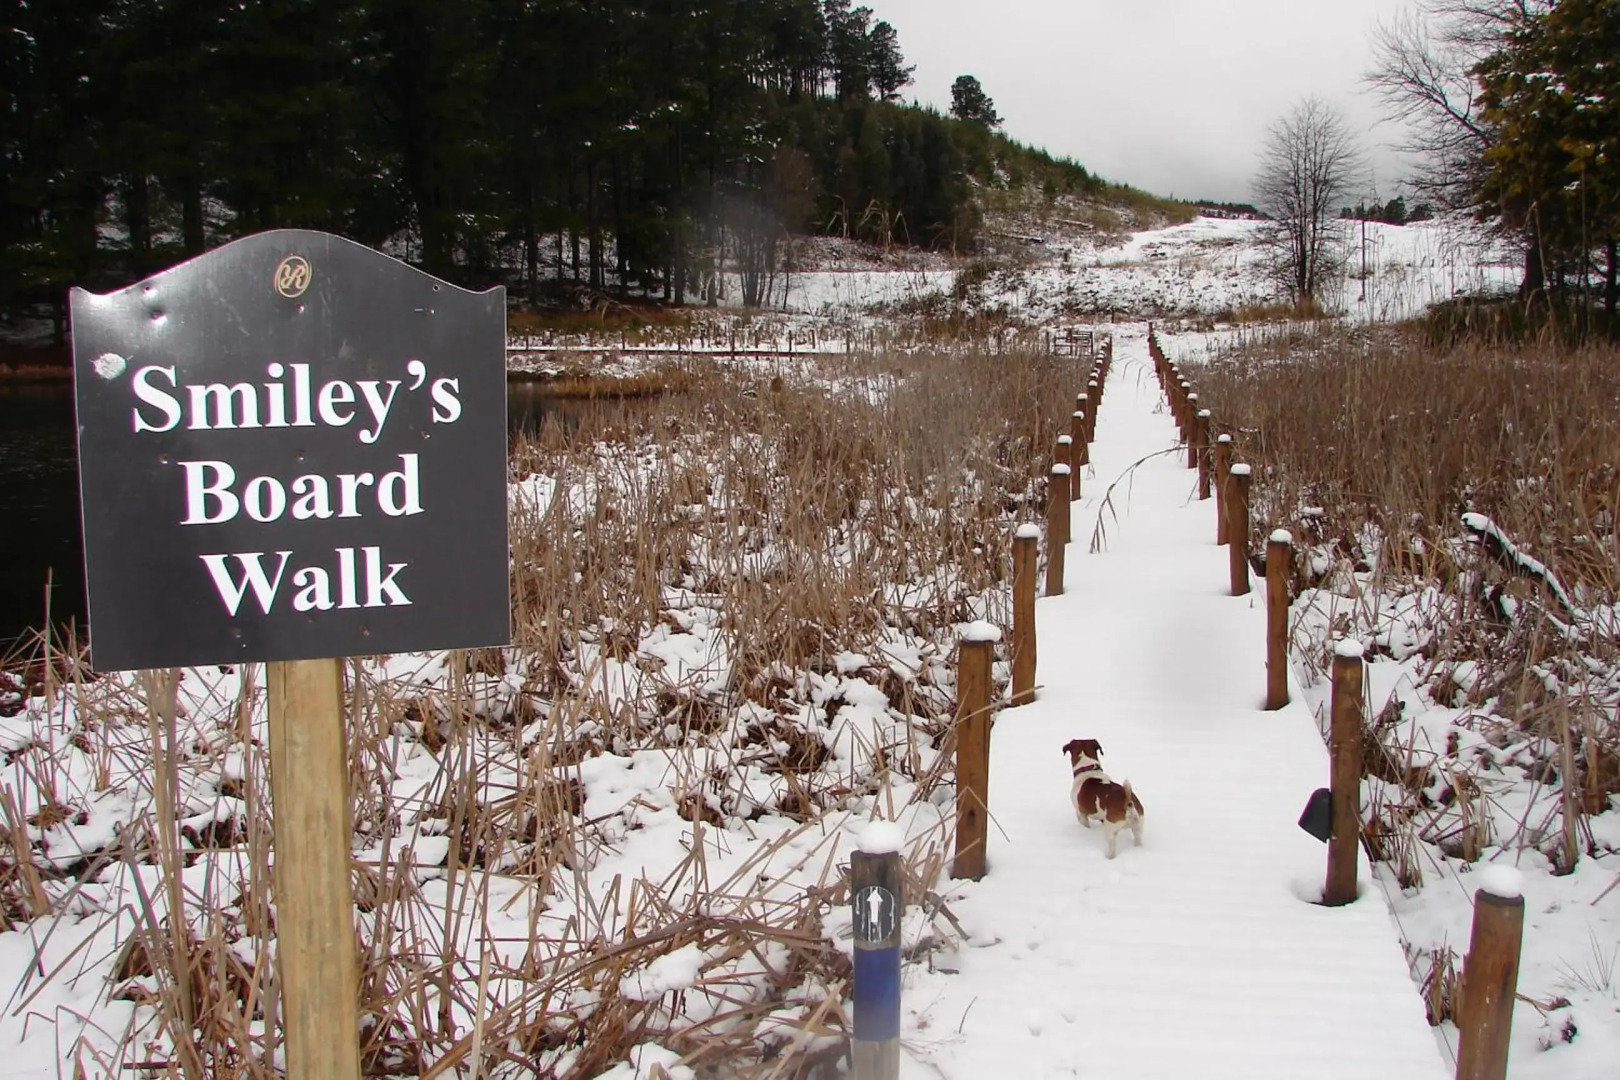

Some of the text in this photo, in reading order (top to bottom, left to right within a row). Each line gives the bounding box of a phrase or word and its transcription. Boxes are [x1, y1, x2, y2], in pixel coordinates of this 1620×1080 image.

[132, 359, 462, 444] Smiley’s
[177, 453, 425, 526] Board
[199, 546, 413, 617] Walk
